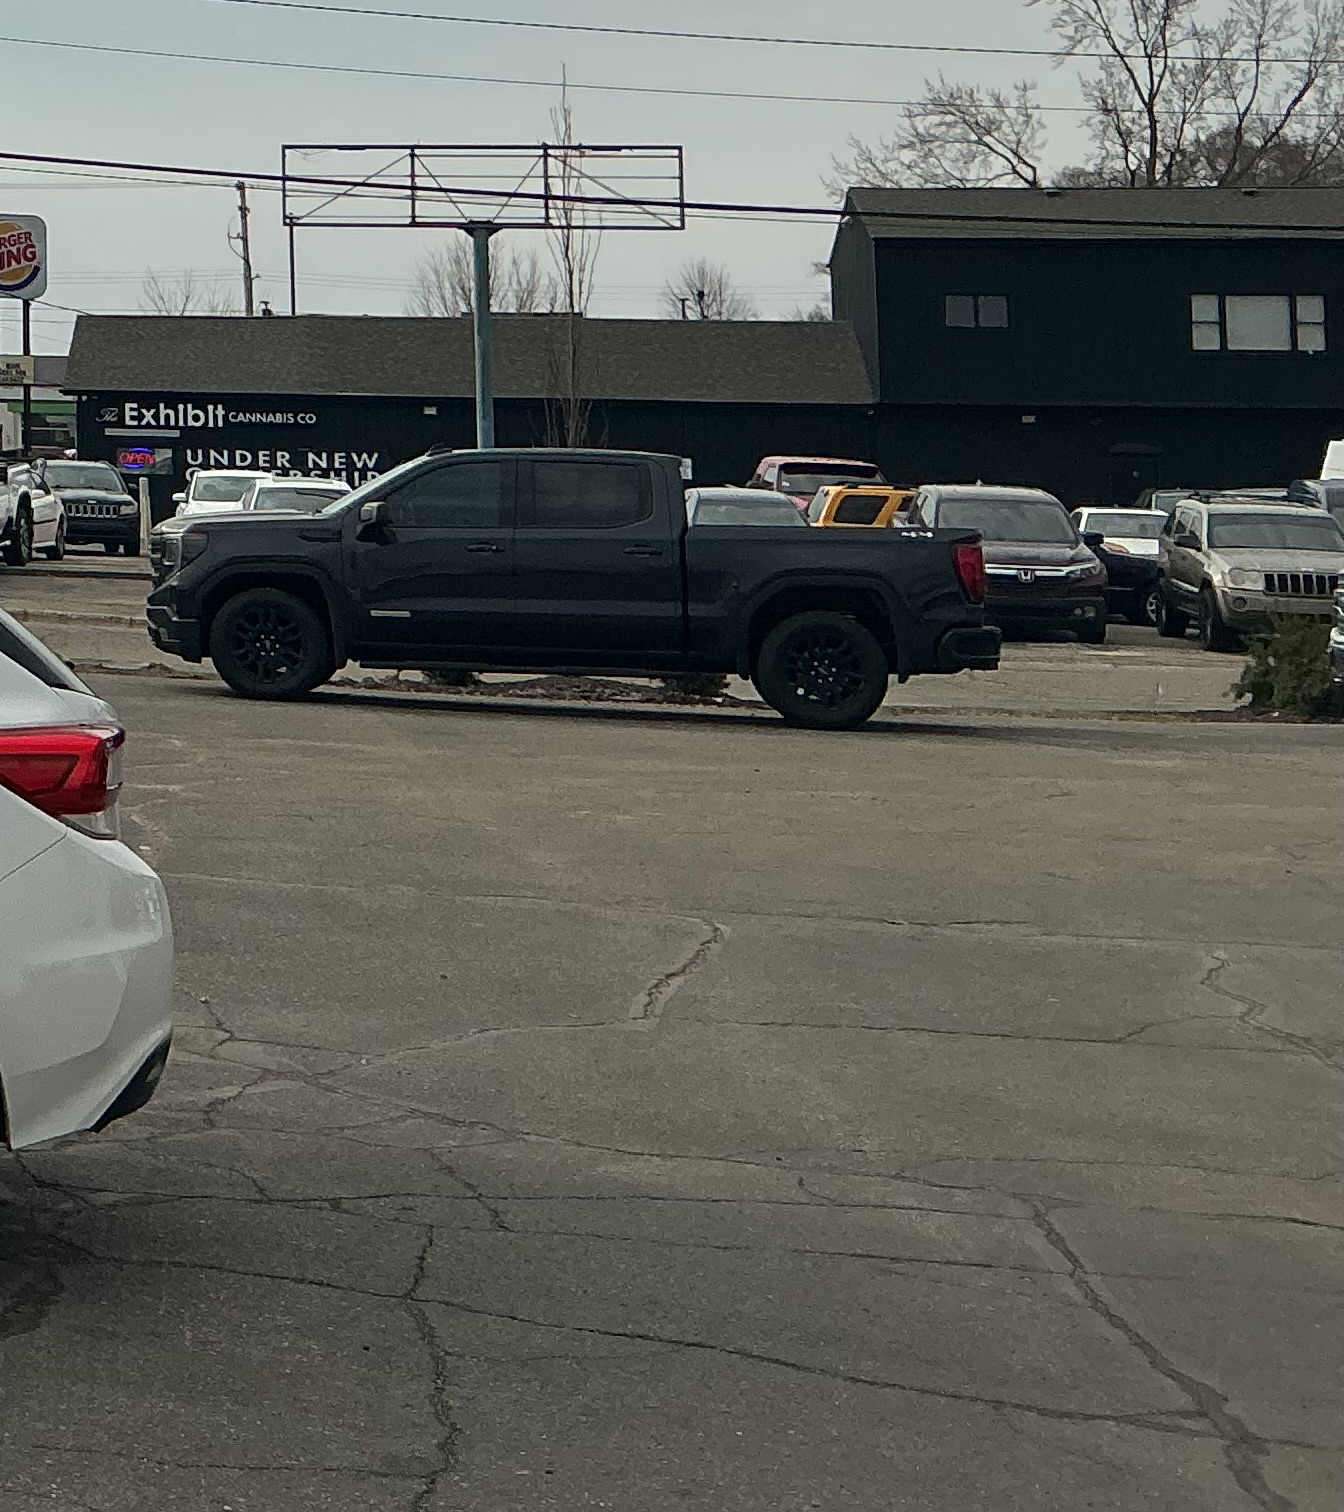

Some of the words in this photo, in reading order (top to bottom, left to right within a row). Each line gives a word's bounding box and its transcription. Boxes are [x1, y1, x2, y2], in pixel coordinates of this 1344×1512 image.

[124, 402, 226, 428] Exhibit
[228, 411, 295, 424] CANNABIS
[297, 413, 317, 424] CO
[118, 452, 156, 466] OPEN
[186, 448, 292, 469] UNDER
[306, 451, 379, 470] NEW
